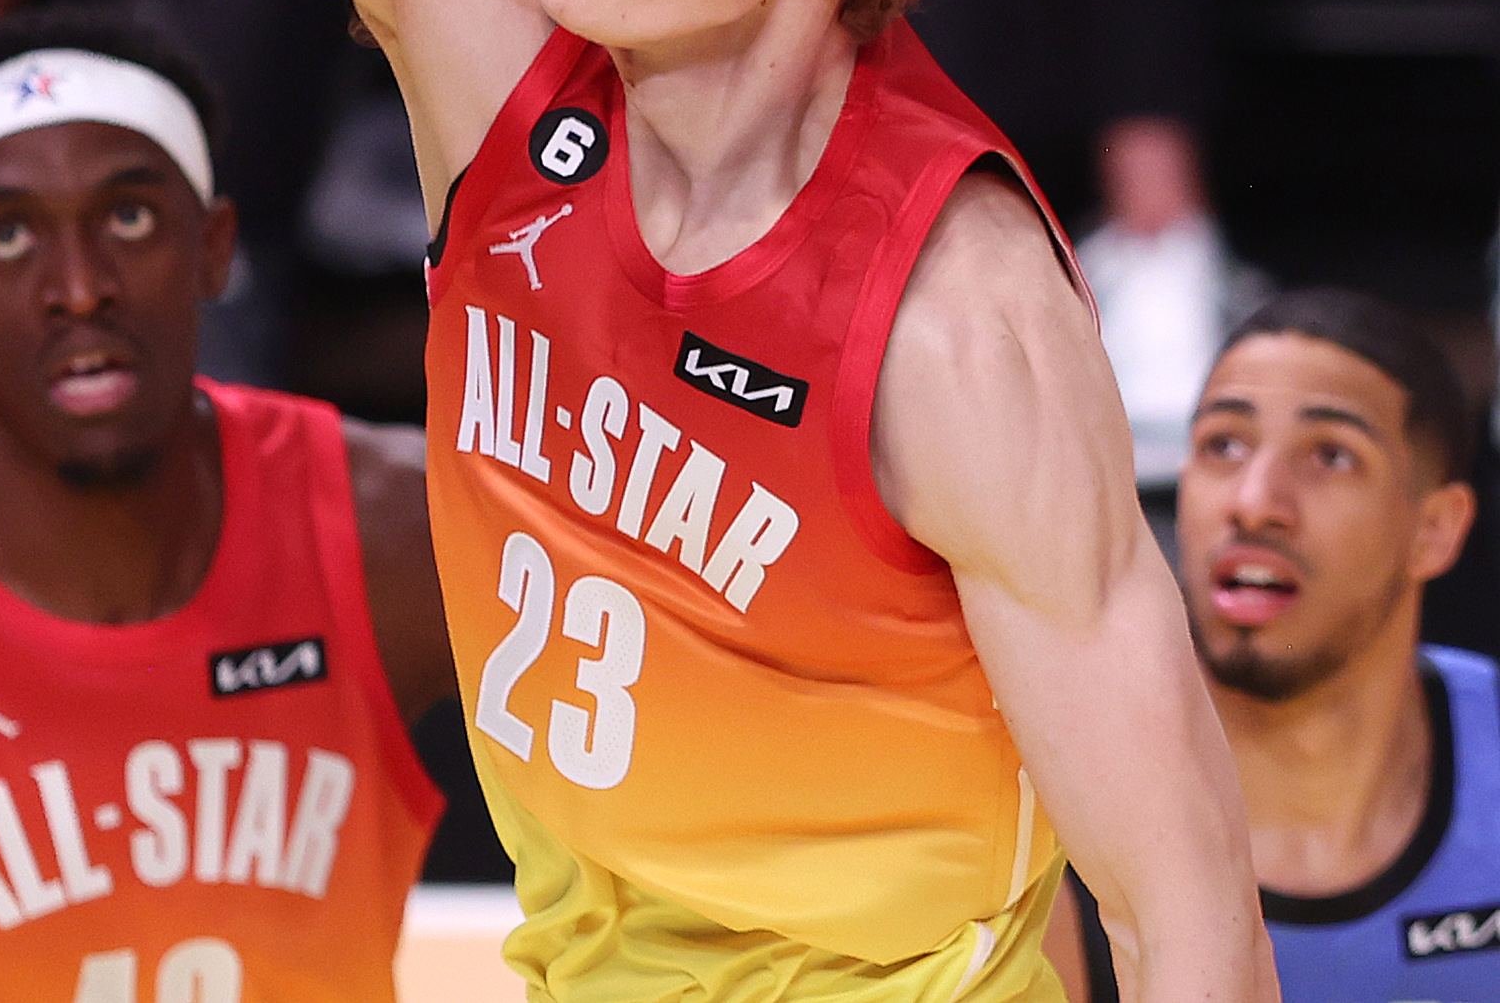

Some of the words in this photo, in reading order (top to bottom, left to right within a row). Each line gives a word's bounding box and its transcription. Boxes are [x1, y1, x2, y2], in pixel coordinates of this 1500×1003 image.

[540, 115, 596, 177] 6
[685, 347, 794, 413] KIA
[456, 304, 799, 614] ALL-STAR
[215, 640, 321, 693] KIA
[474, 530, 647, 791] 23
